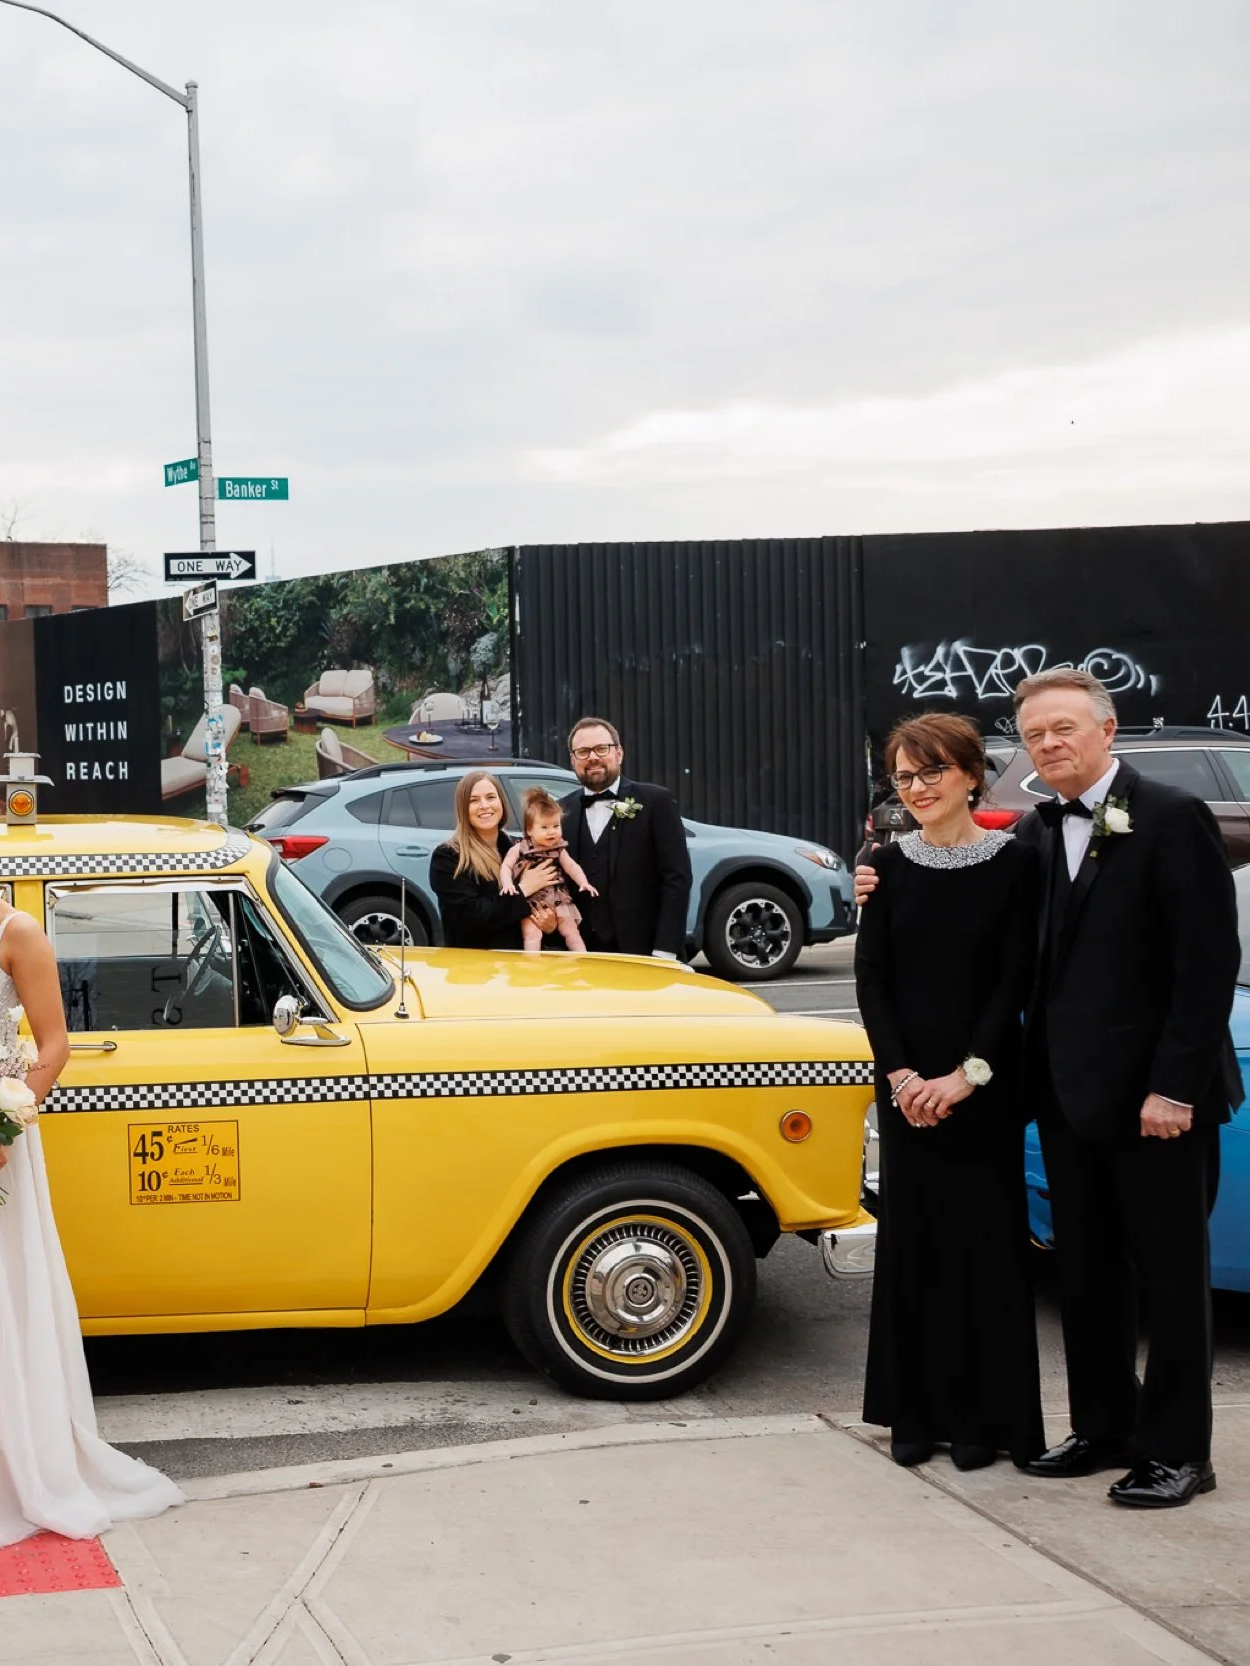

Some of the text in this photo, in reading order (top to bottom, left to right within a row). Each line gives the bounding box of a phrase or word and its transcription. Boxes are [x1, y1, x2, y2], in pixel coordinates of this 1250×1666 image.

[166, 465, 188, 485] Wythe
[225, 479, 279, 498] Banker St
[177, 560, 242, 572] ONE WAY
[64, 680, 127, 703] DESIGN
[64, 720, 128, 742] WITHIN
[66, 761, 128, 780] REACH
[167, 1124, 200, 1134] RATES
[174, 1168, 195, 1176] Each
[178, 1193, 191, 1201] TIME
[211, 1191, 233, 1199] MOTION
